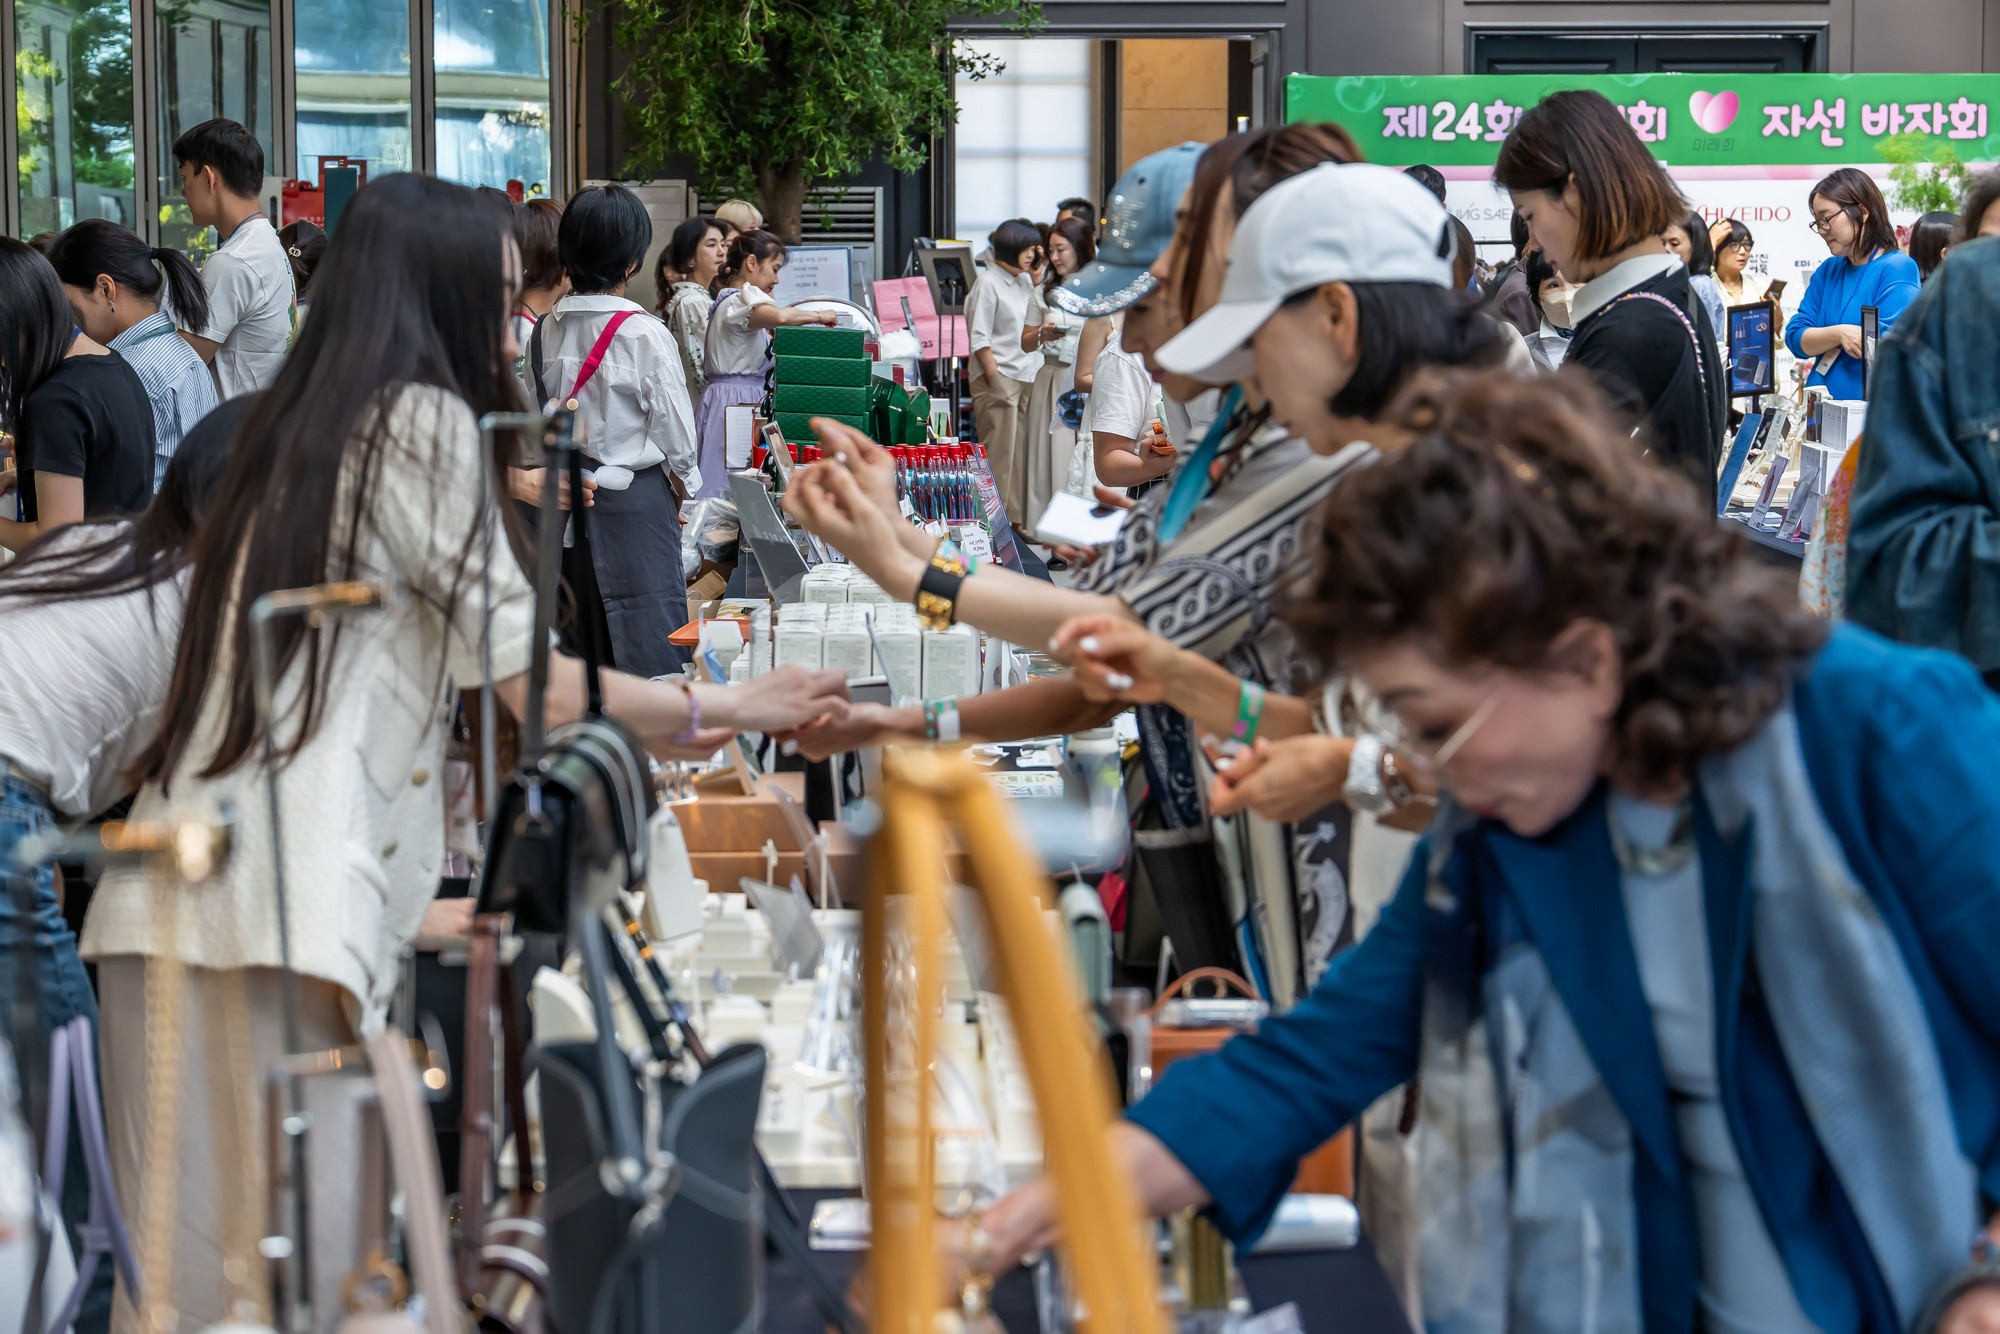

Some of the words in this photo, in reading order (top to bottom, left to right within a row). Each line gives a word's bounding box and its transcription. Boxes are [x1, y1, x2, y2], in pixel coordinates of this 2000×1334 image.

[1761, 97, 1846, 147] 자선
[1860, 96, 1988, 140] 바자회
[1692, 138, 1735, 152] 미래회
[1483, 208, 1513, 221] SAE
